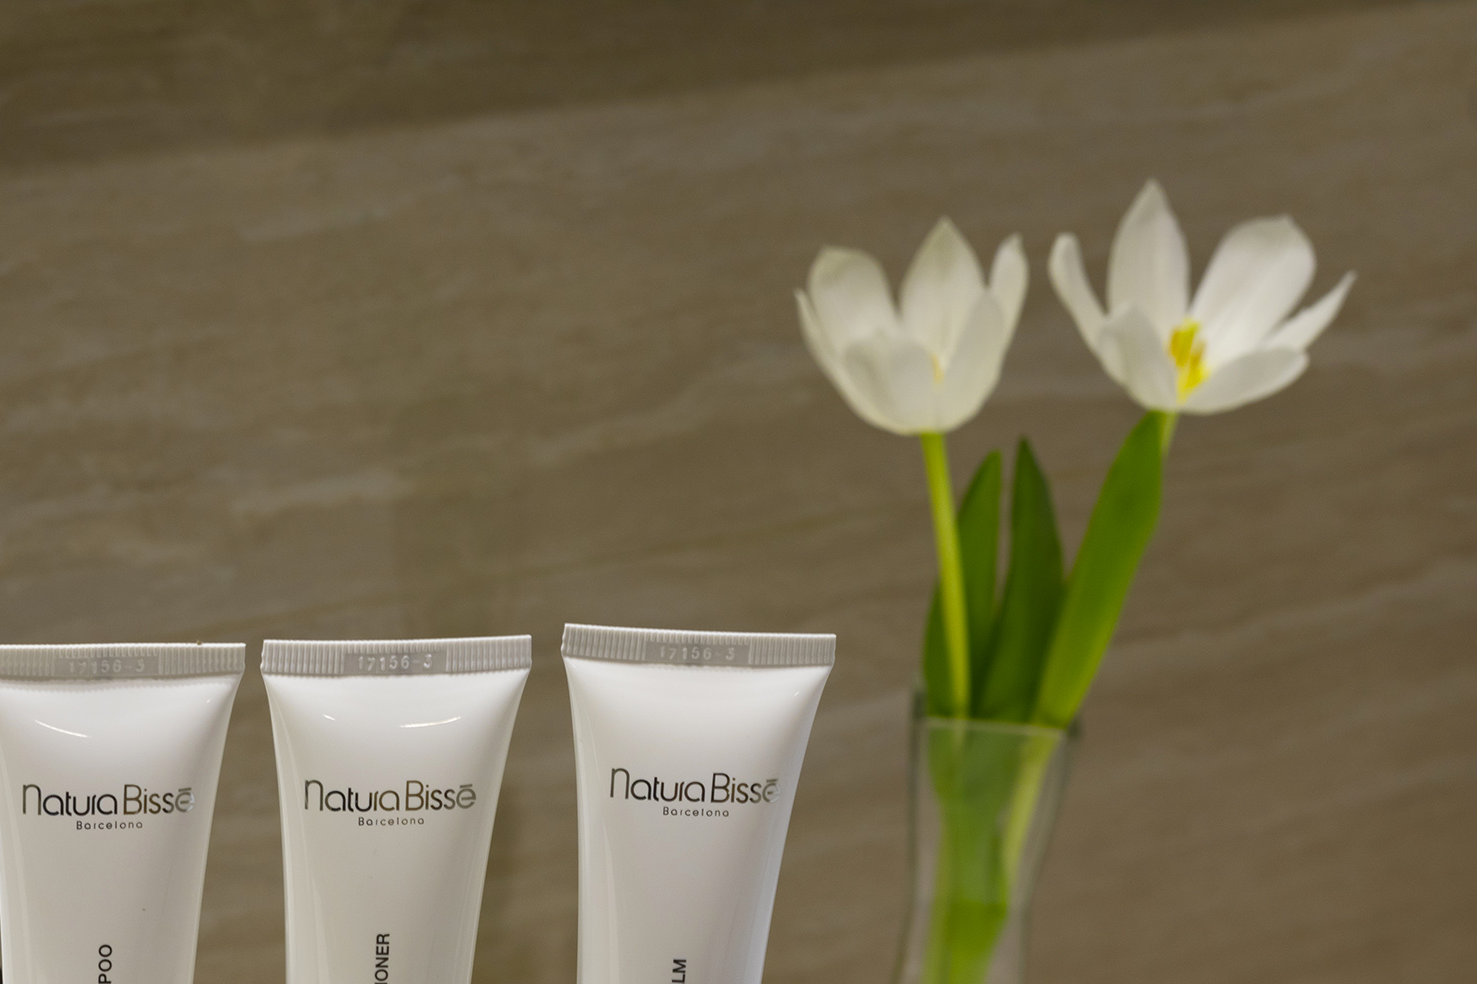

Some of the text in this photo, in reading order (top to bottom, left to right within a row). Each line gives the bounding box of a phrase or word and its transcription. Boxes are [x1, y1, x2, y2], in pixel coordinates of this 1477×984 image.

[304, 779, 400, 812] Natura
[610, 768, 705, 802] Natura
[22, 784, 118, 816] Natura
[358, 816, 425, 826] Barcelona
[662, 806, 730, 818] Barcelona
[76, 820, 143, 830] Barcelona
